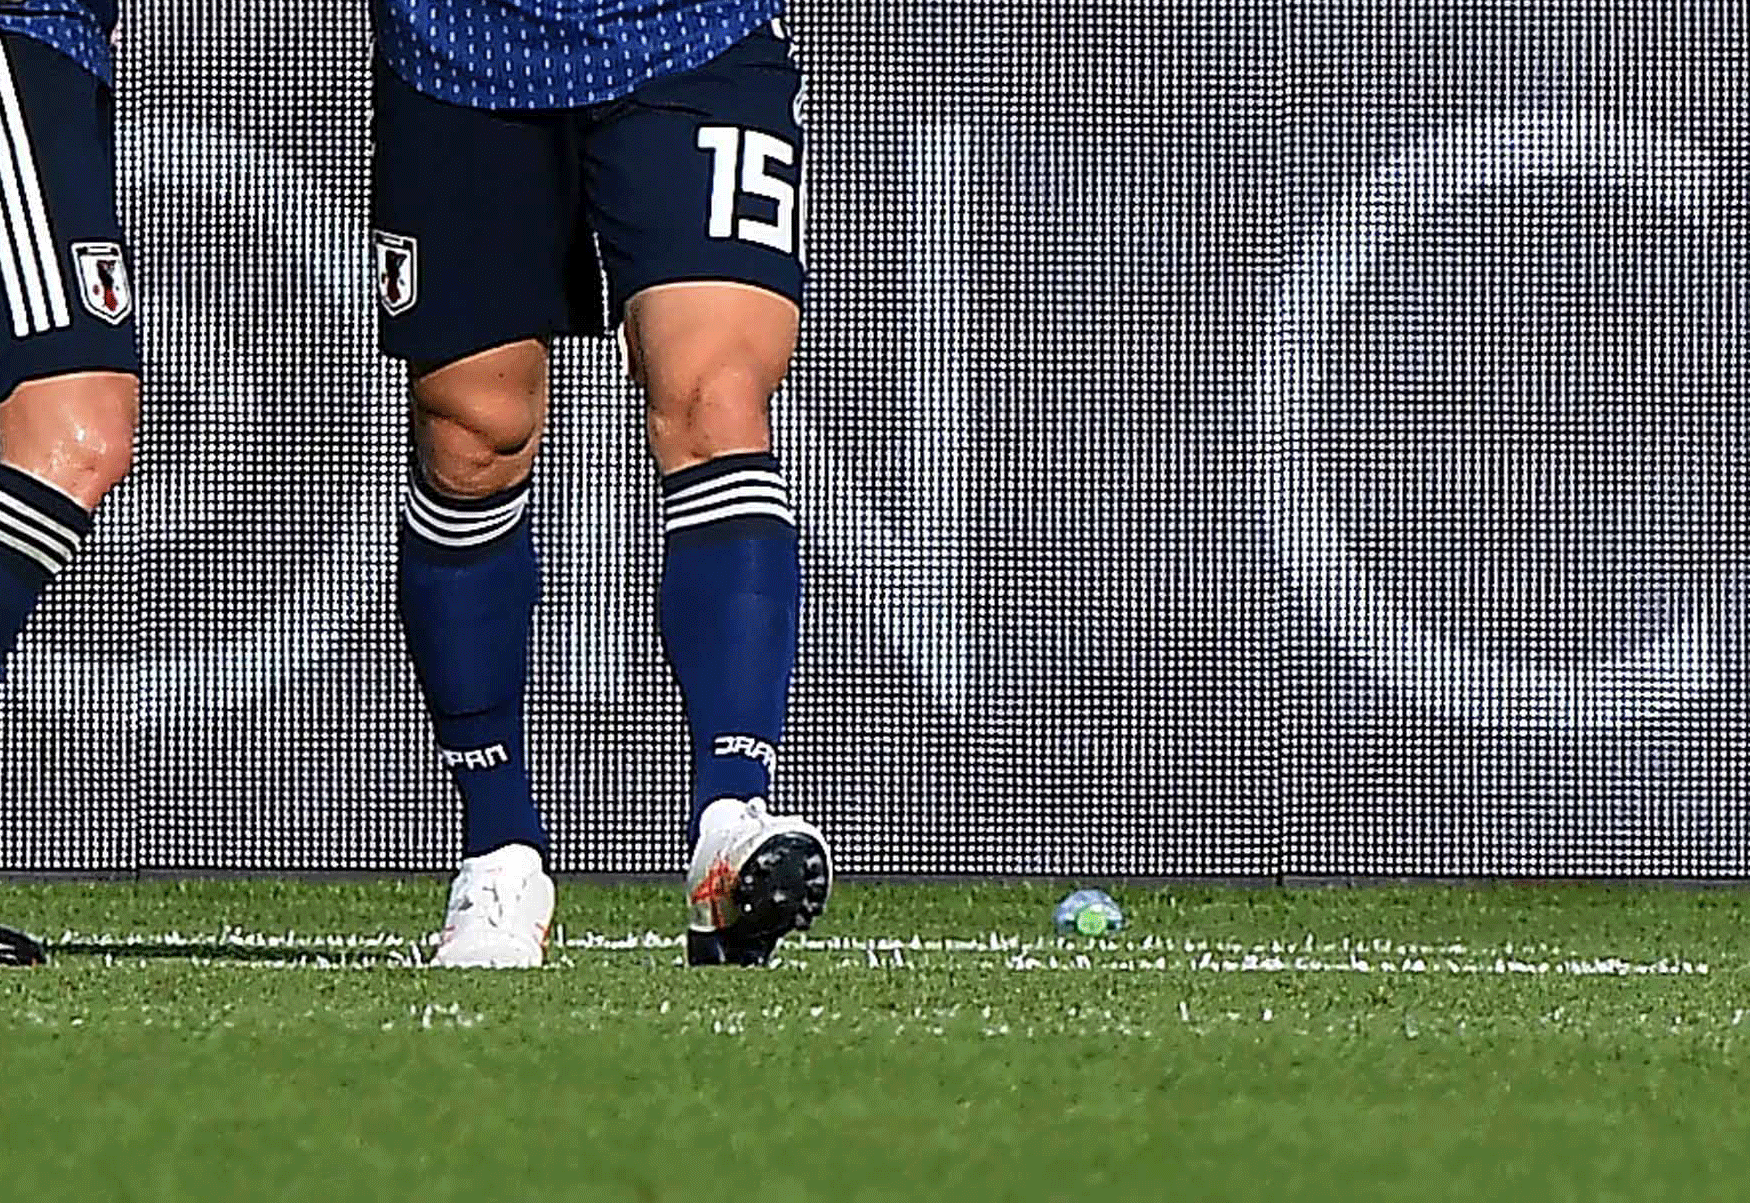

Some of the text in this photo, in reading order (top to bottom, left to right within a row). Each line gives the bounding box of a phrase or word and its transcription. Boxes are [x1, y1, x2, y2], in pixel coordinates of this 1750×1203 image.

[698, 127, 795, 253] 15
[436, 743, 508, 770] PAN
[713, 735, 776, 782] JAP
